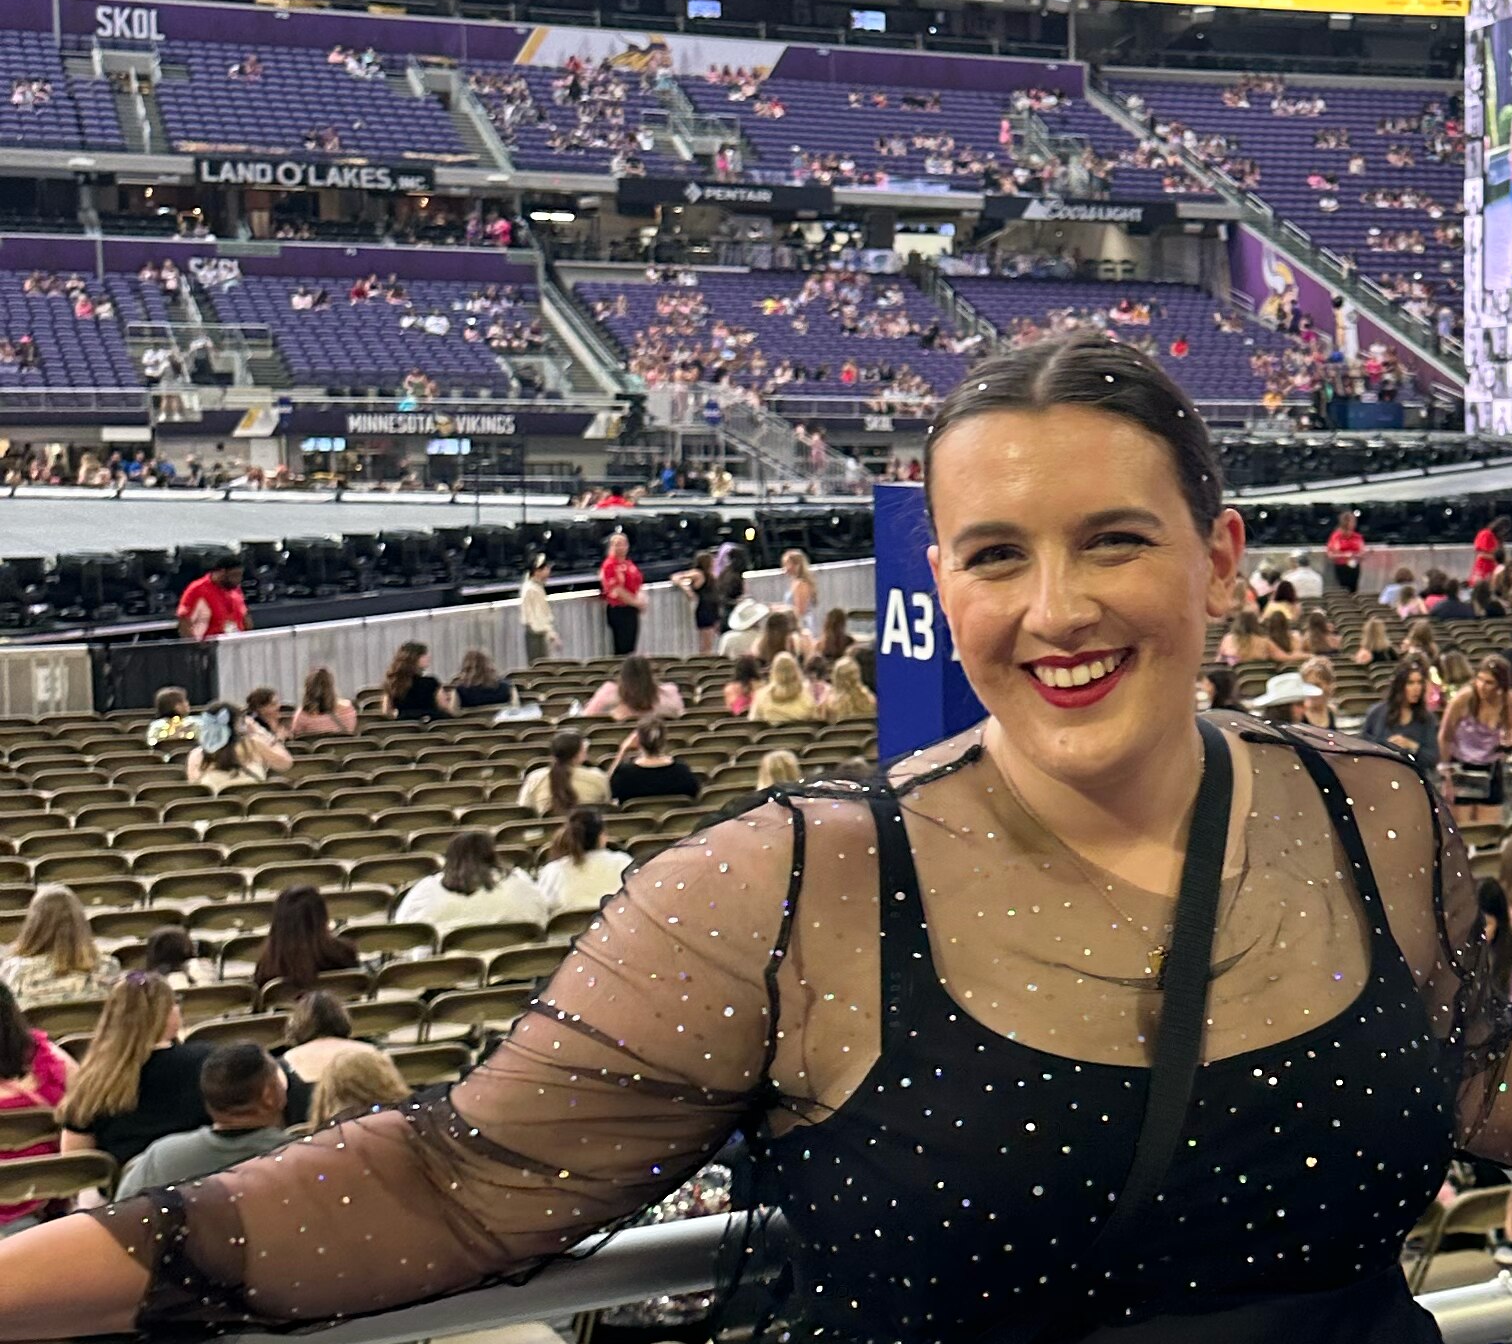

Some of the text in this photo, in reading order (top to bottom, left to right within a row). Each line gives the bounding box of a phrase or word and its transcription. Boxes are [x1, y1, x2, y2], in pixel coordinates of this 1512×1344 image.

[96, 4, 166, 41] SKOL
[201, 160, 272, 184] LAND
[704, 187, 774, 203] PENTAIR
[348, 413, 516, 436] MINNESOTA VIKINGS
[881, 587, 935, 662] A3
